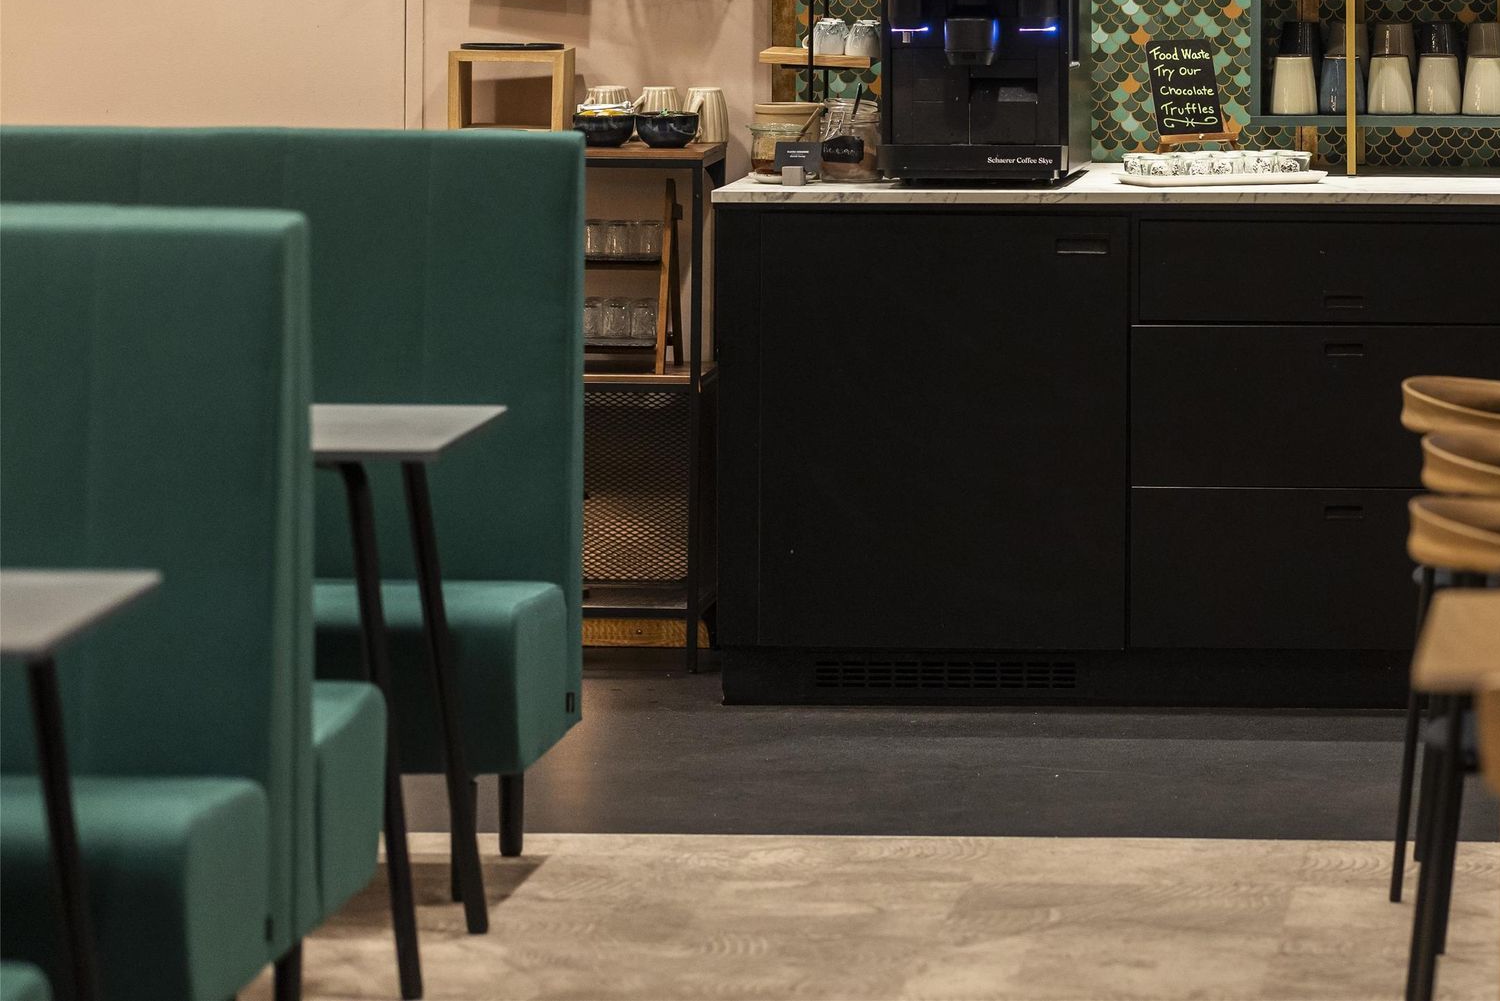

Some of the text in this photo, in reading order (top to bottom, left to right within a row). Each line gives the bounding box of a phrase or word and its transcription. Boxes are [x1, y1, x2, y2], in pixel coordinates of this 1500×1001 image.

[1149, 46, 1211, 61] Food Waste
[1153, 64, 1202, 81] Try Our
[1160, 85, 1215, 96] Chocolate
[1160, 101, 1215, 116] Truffles
[987, 156, 1016, 164] Schaerer
[1038, 157, 1053, 165] Skye
